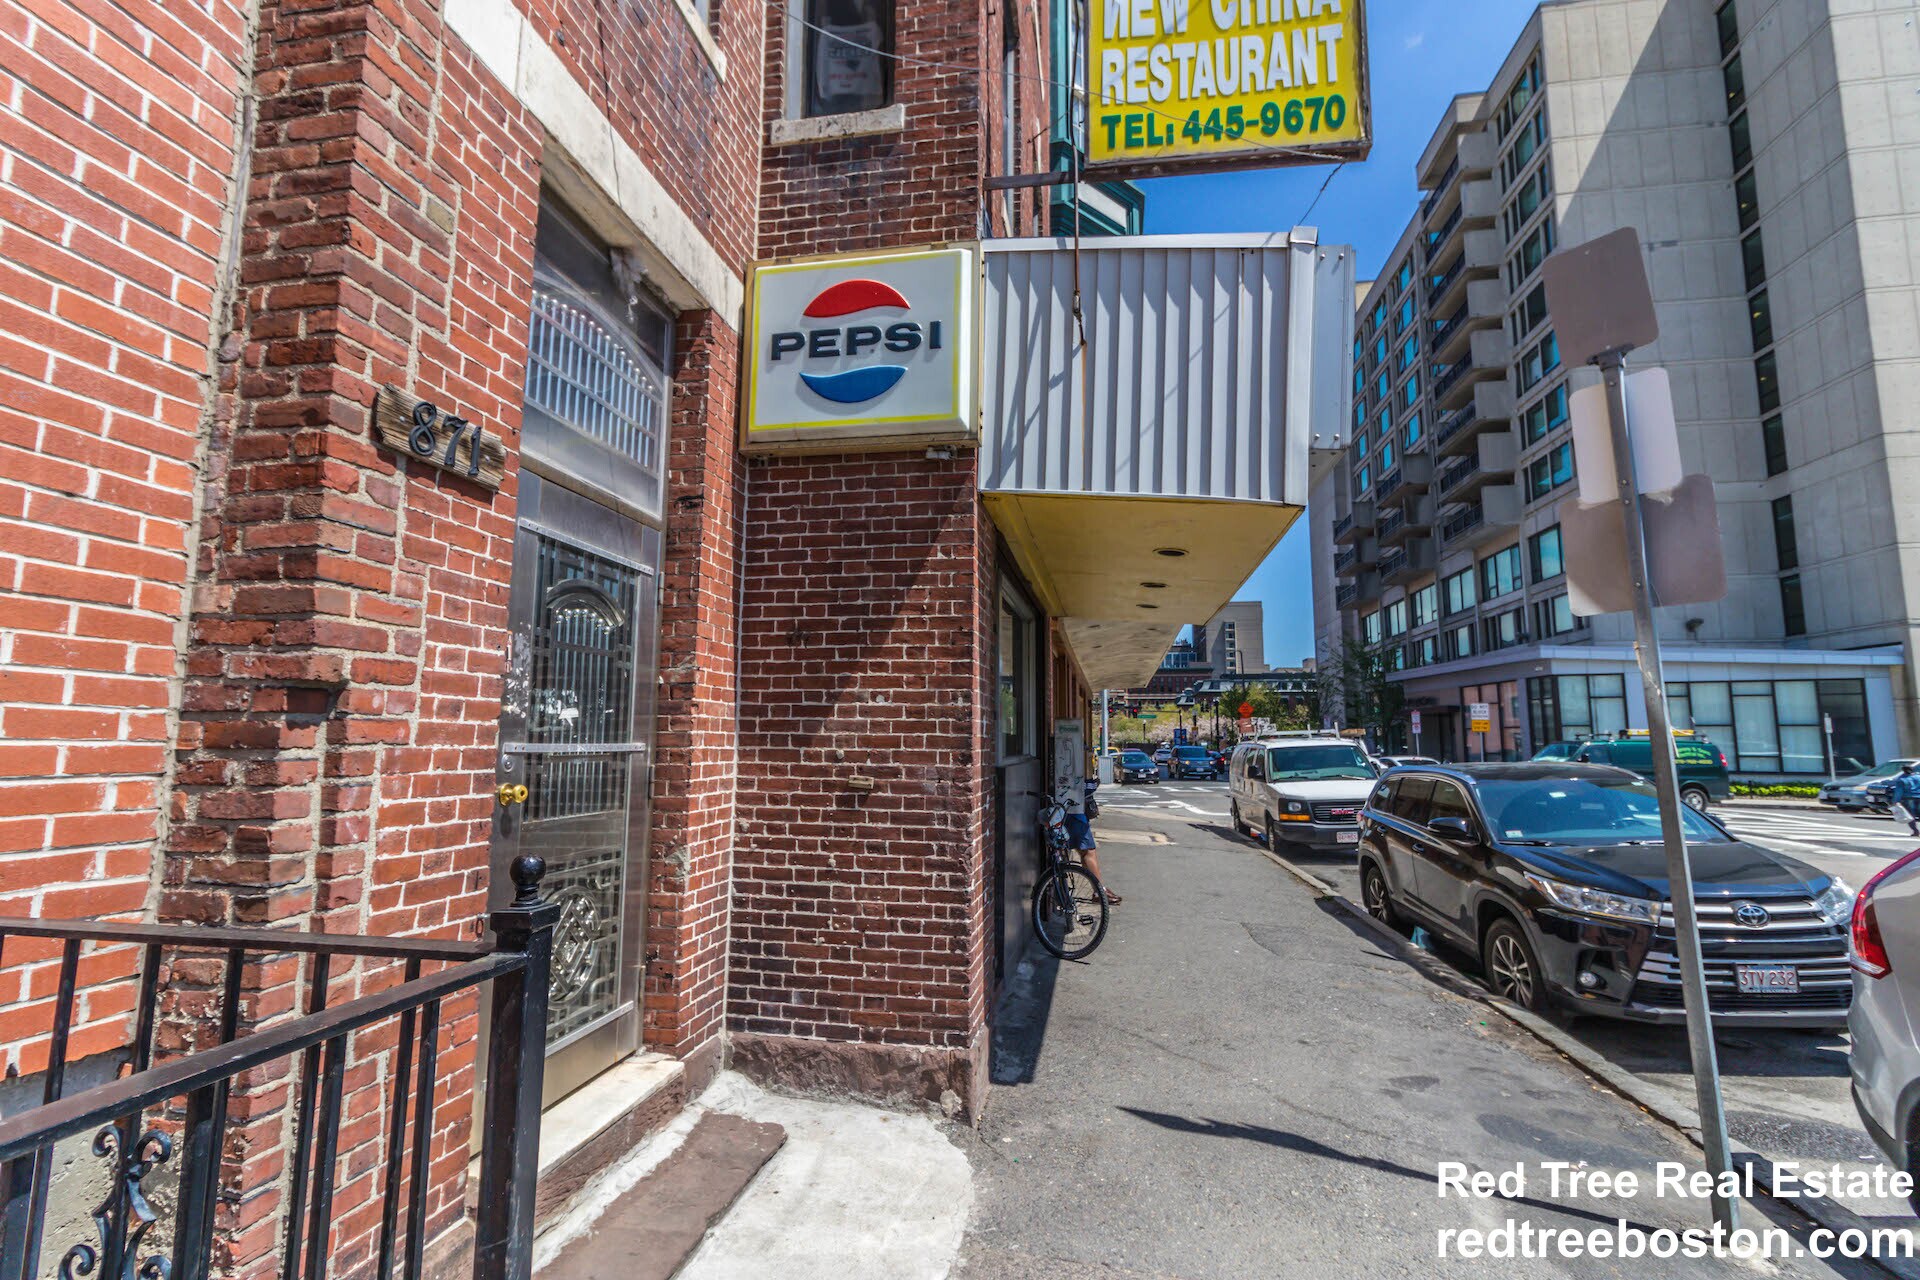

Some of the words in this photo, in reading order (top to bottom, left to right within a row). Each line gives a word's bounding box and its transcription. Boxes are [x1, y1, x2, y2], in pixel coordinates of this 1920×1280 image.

[1101, 23, 1343, 105] RESTAURANT
[1101, 112, 1174, 149] TEL:
[1182, 94, 1346, 143] 445-9670
[771, 319, 942, 360] PEPSI
[409, 401, 482, 476] 871
[1769, 970, 1796, 986] 232
